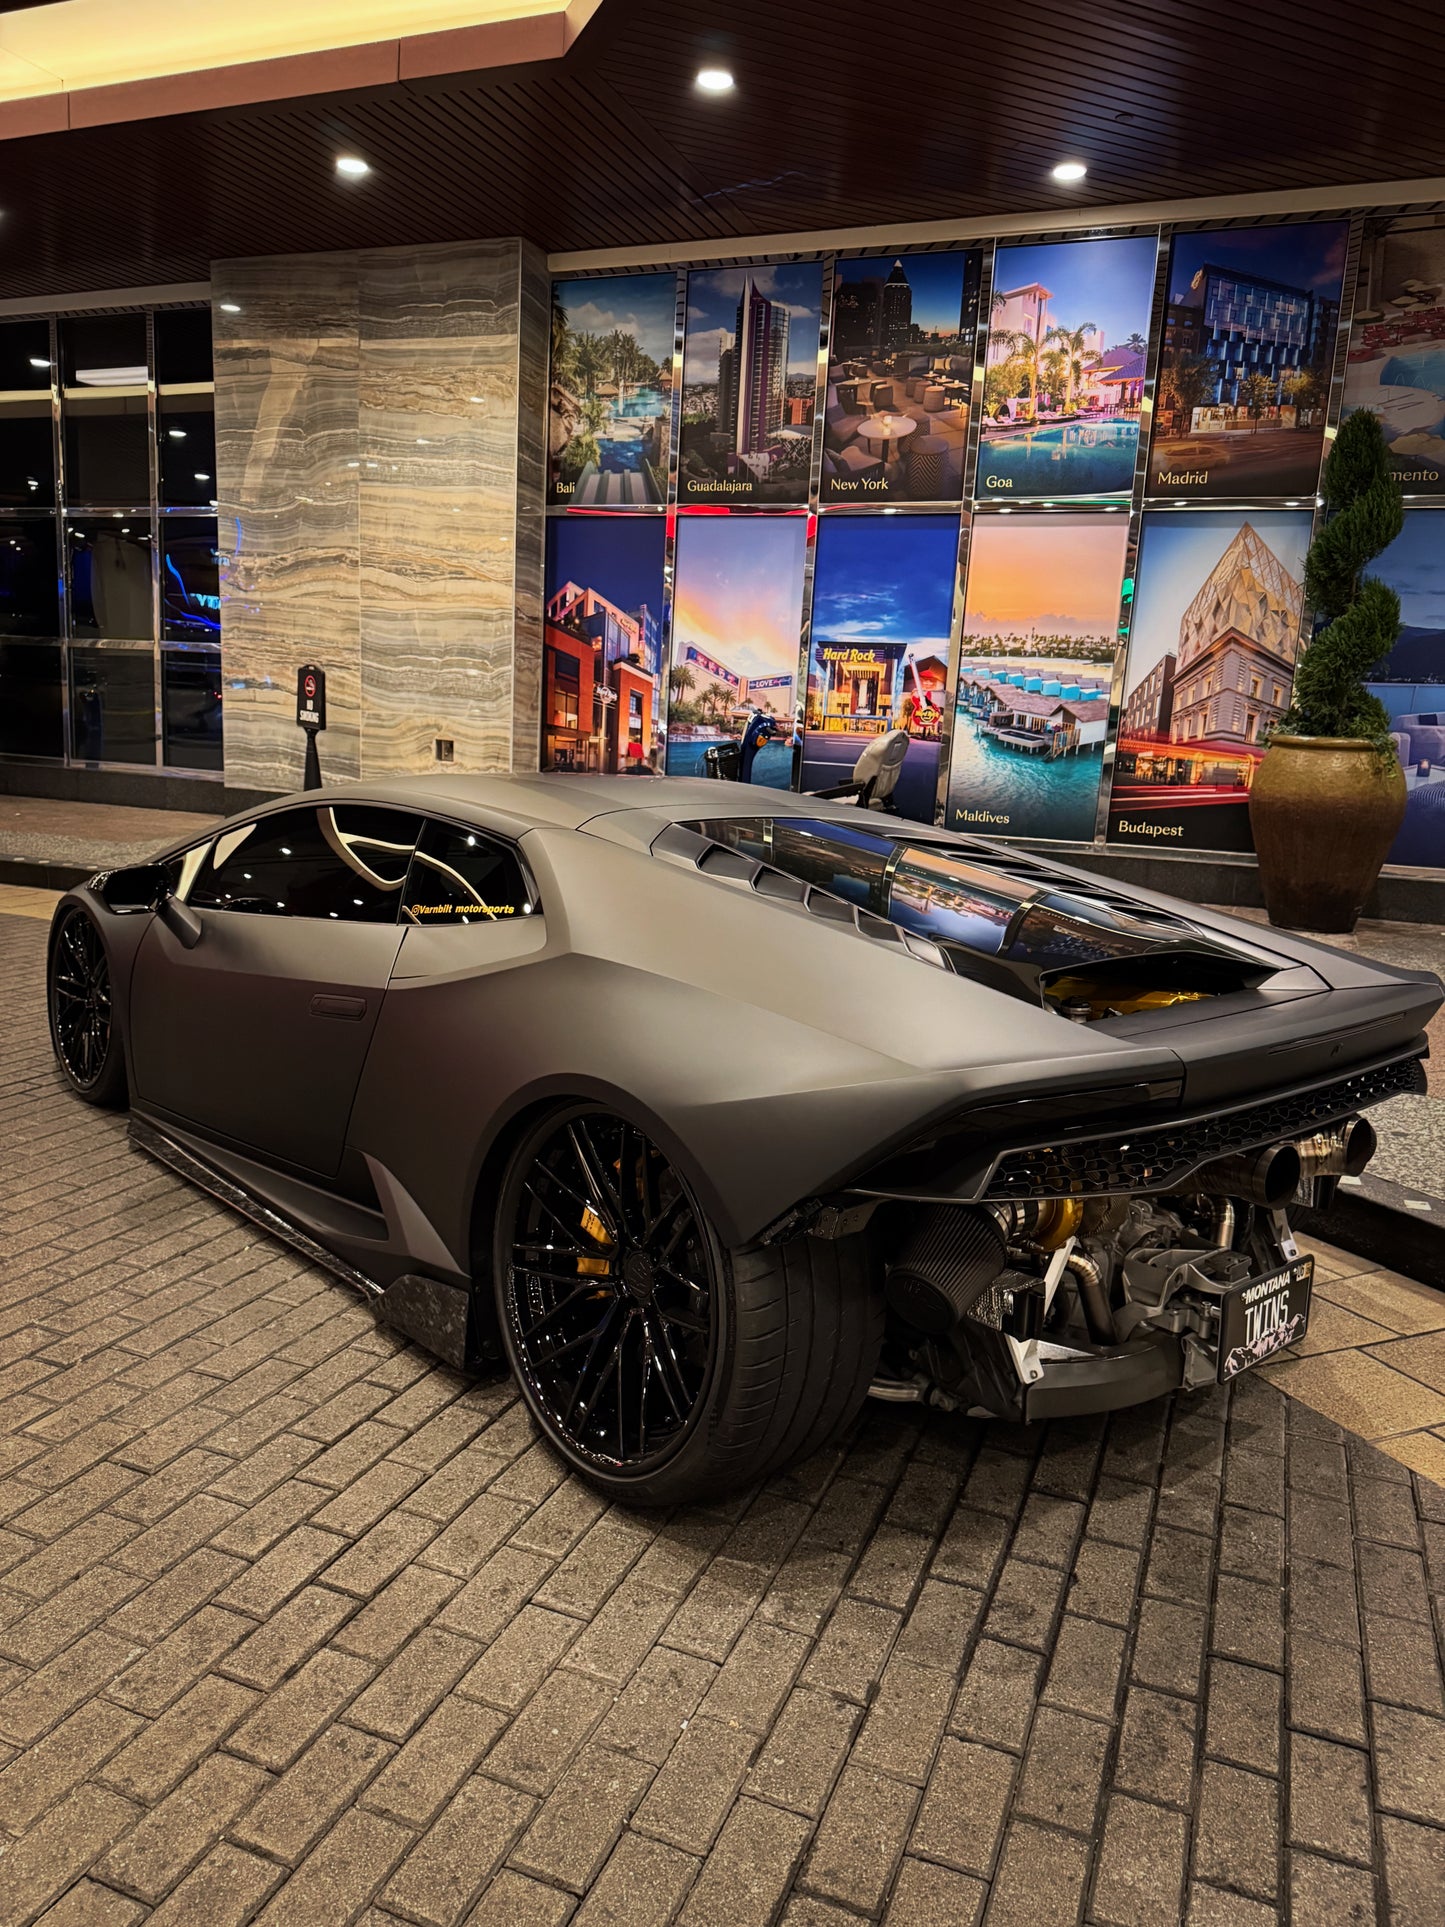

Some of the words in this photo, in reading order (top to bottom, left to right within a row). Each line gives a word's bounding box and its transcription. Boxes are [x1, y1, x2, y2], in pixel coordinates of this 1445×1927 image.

[830, 478, 859, 490] New
[861, 477, 889, 490] York
[986, 475, 1013, 488] Goa
[1157, 470, 1209, 485] Madrid
[556, 481, 575, 494] Bali
[687, 479, 753, 494] Guadalajara
[822, 647, 850, 661] Hard
[850, 648, 876, 663] Rock
[756, 679, 774, 688] LOVE
[955, 808, 1010, 825] Maldives
[1118, 820, 1184, 838] Budapest
[411, 904, 453, 916] @Varnbilt
[455, 904, 515, 915] motorsports
[1244, 1270, 1291, 1305] MONTANA
[1244, 1289, 1291, 1347] TWINS
